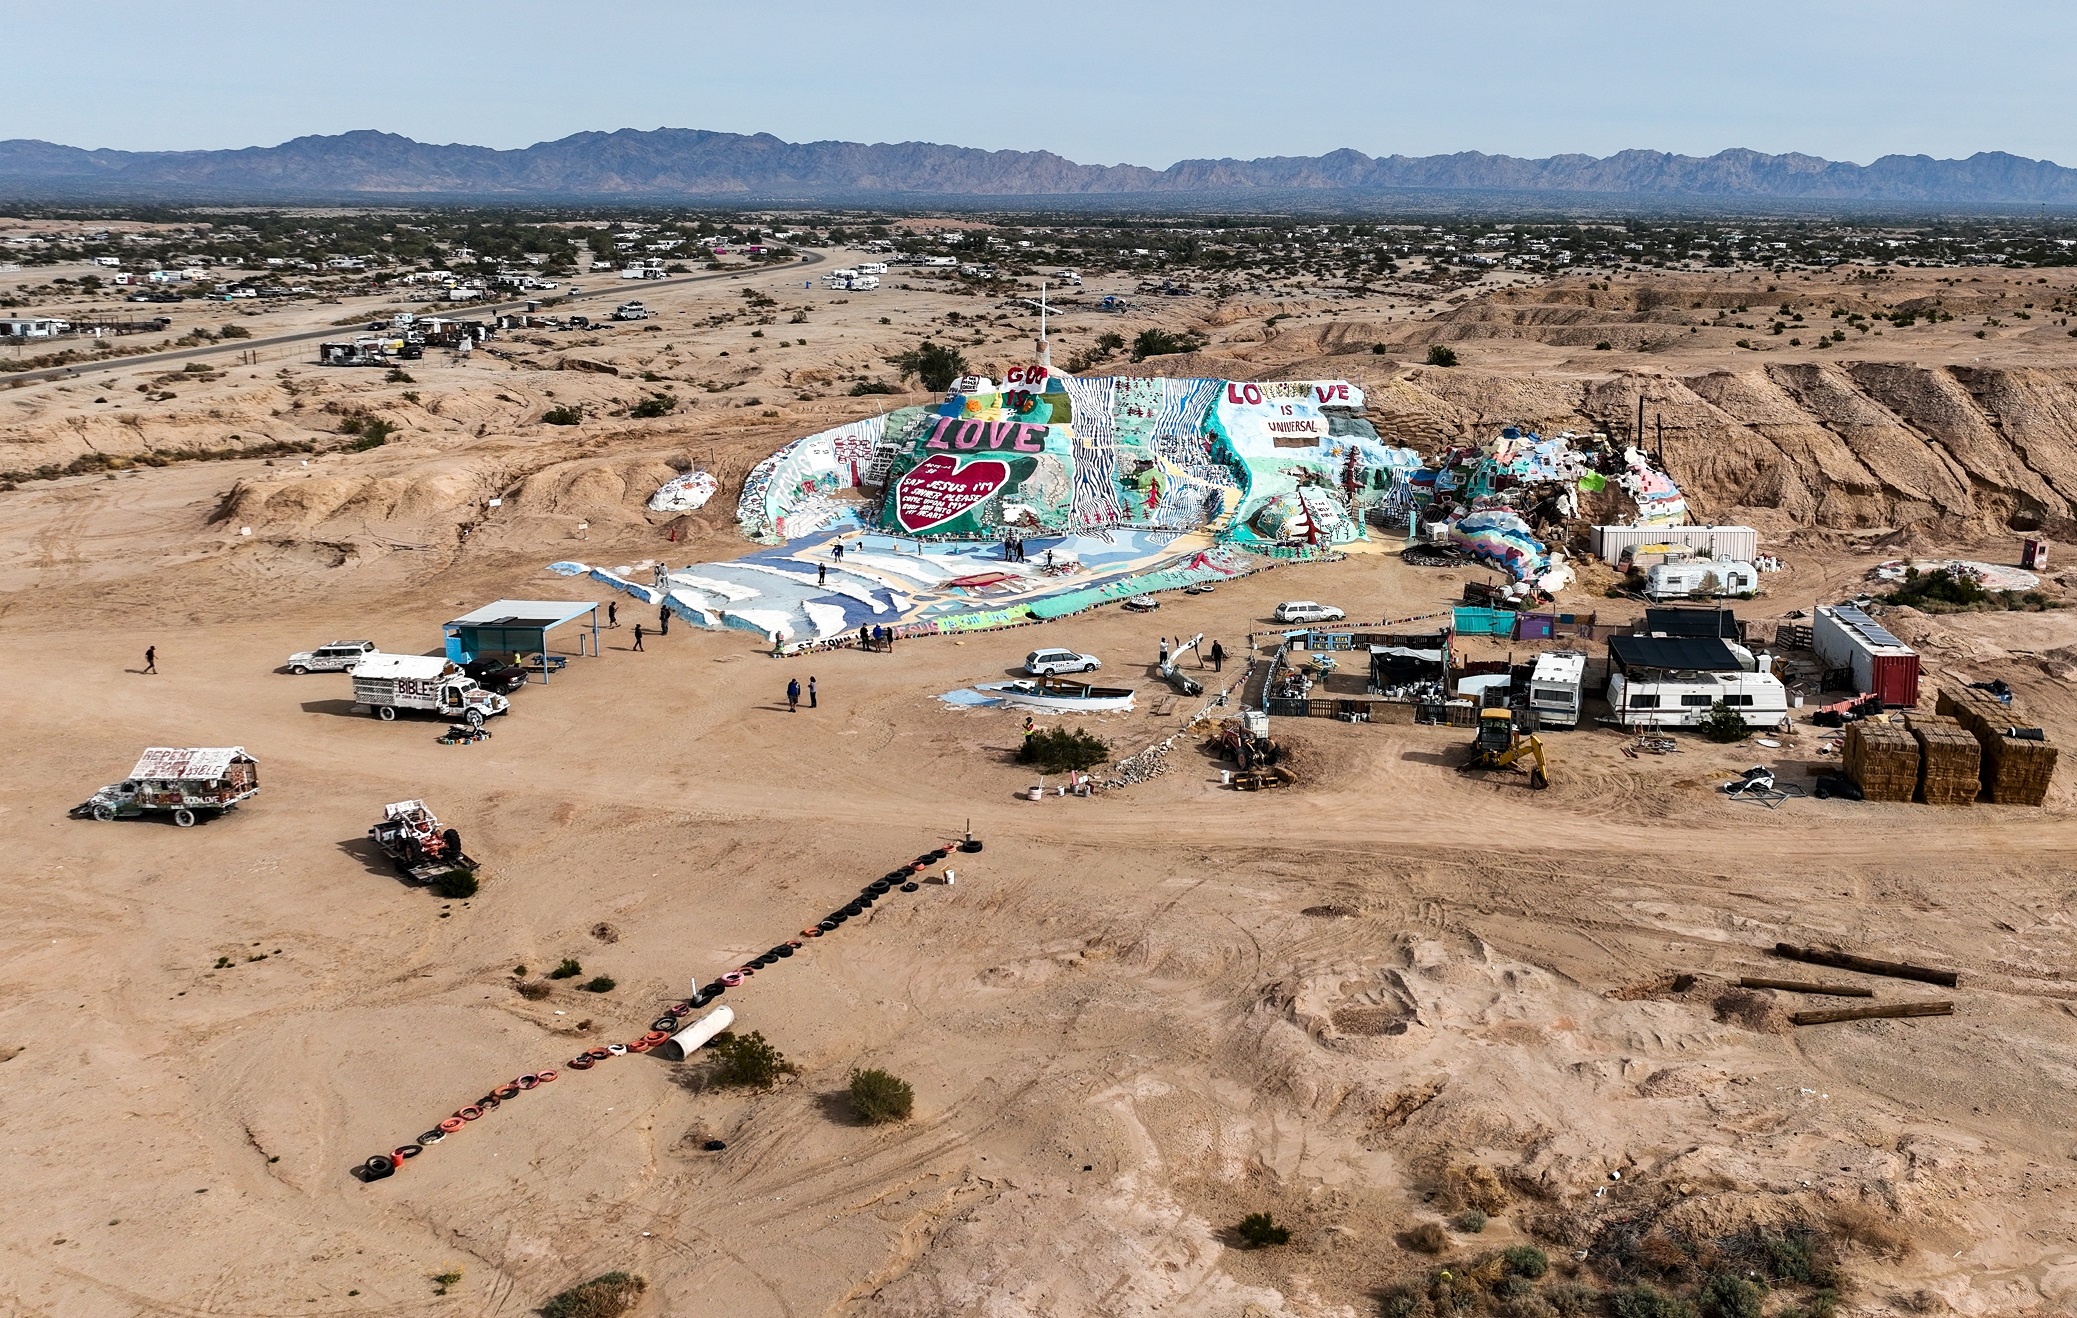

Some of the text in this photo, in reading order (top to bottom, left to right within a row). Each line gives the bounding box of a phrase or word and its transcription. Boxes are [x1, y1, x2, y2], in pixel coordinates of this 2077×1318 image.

[1006, 389, 1029, 407] IS
[1280, 405, 1293, 416] IS
[1268, 420, 1318, 433] UNIVERSAL
[926, 417, 1045, 452] LOVE
[904, 478, 994, 492] SAY JESUS I'M
[902, 496, 967, 510] COME UPON MY
[942, 493, 982, 502] PLEASE
[916, 510, 945, 519] HEART
[934, 506, 952, 515] INTO
[797, 642, 815, 651] ST
[820, 635, 852, 648] JOHN
[398, 680, 430, 696] BIBLE
[142, 750, 198, 761] REPENT
